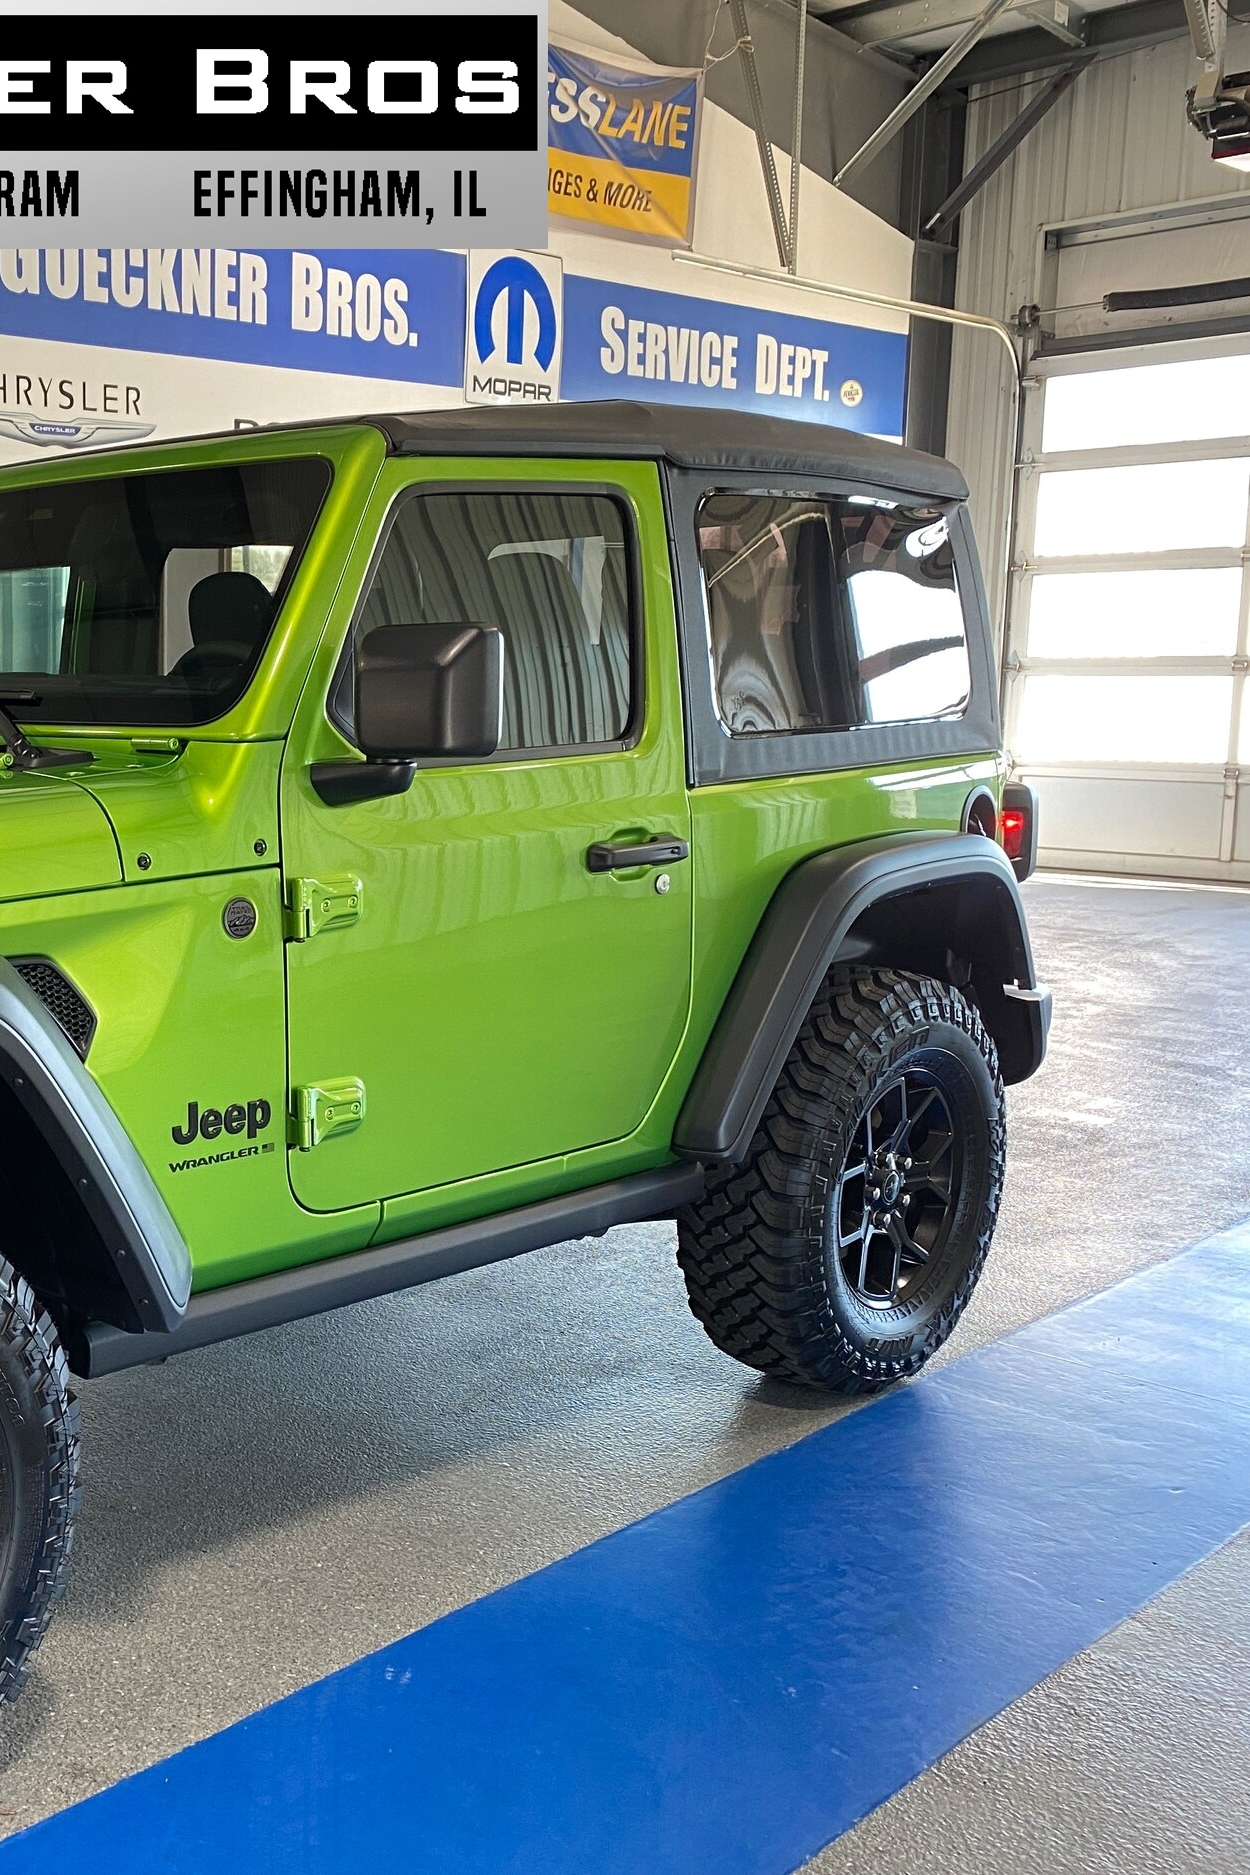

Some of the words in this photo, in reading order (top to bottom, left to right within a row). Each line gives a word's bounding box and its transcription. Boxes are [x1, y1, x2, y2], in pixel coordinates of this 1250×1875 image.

[586, 178, 598, 203] &
[603, 181, 652, 213] MORE
[291, 251, 418, 347] BROS.
[600, 306, 739, 390] SERVICE
[755, 333, 830, 402] DEPT.
[472, 374, 552, 402] MOPAR
[34, 425, 76, 434] CHRYSLER
[171, 1098, 271, 1146] Jeep
[168, 1146, 260, 1173] WRANGLER
